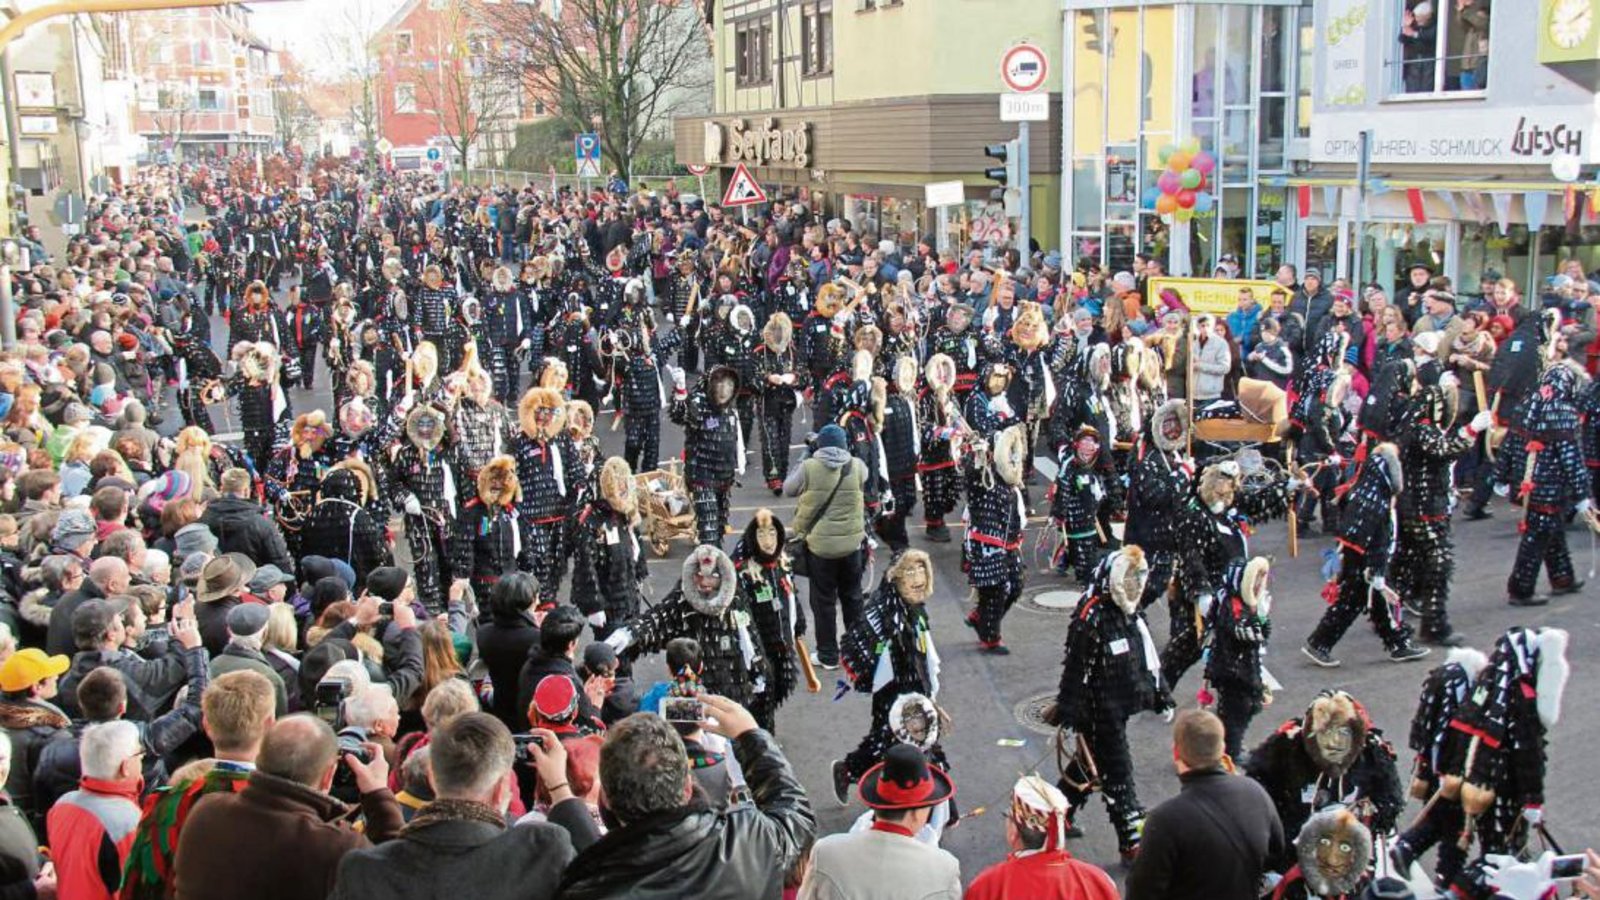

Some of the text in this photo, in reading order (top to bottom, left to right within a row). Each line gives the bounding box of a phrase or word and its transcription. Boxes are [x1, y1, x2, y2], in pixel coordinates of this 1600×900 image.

[730, 117, 808, 169] Seyfang
[1324, 140, 1360, 156] OPTIK
[1372, 139, 1417, 156] UHREN
[1429, 138, 1502, 156] SCHMUCK
